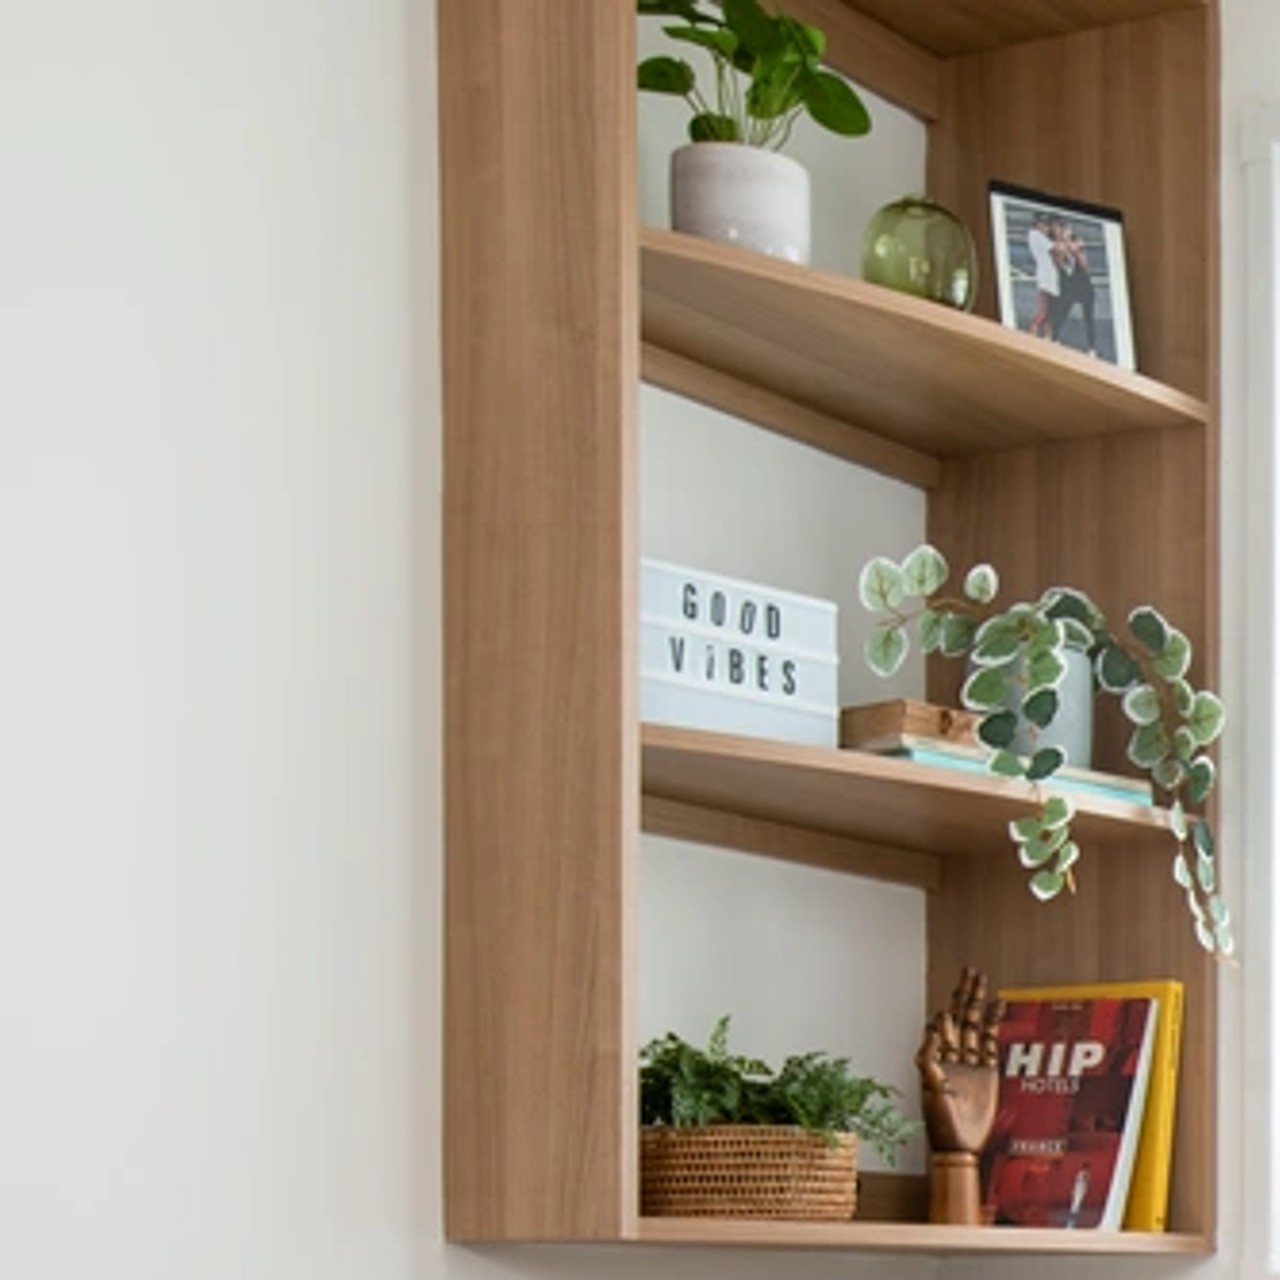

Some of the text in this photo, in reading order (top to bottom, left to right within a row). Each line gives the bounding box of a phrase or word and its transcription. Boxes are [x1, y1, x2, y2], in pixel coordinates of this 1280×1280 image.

[682, 582, 781, 640] GOOD
[1005, 1042, 1106, 1077] HIP
[1020, 1077, 1080, 1095] HOTELS
